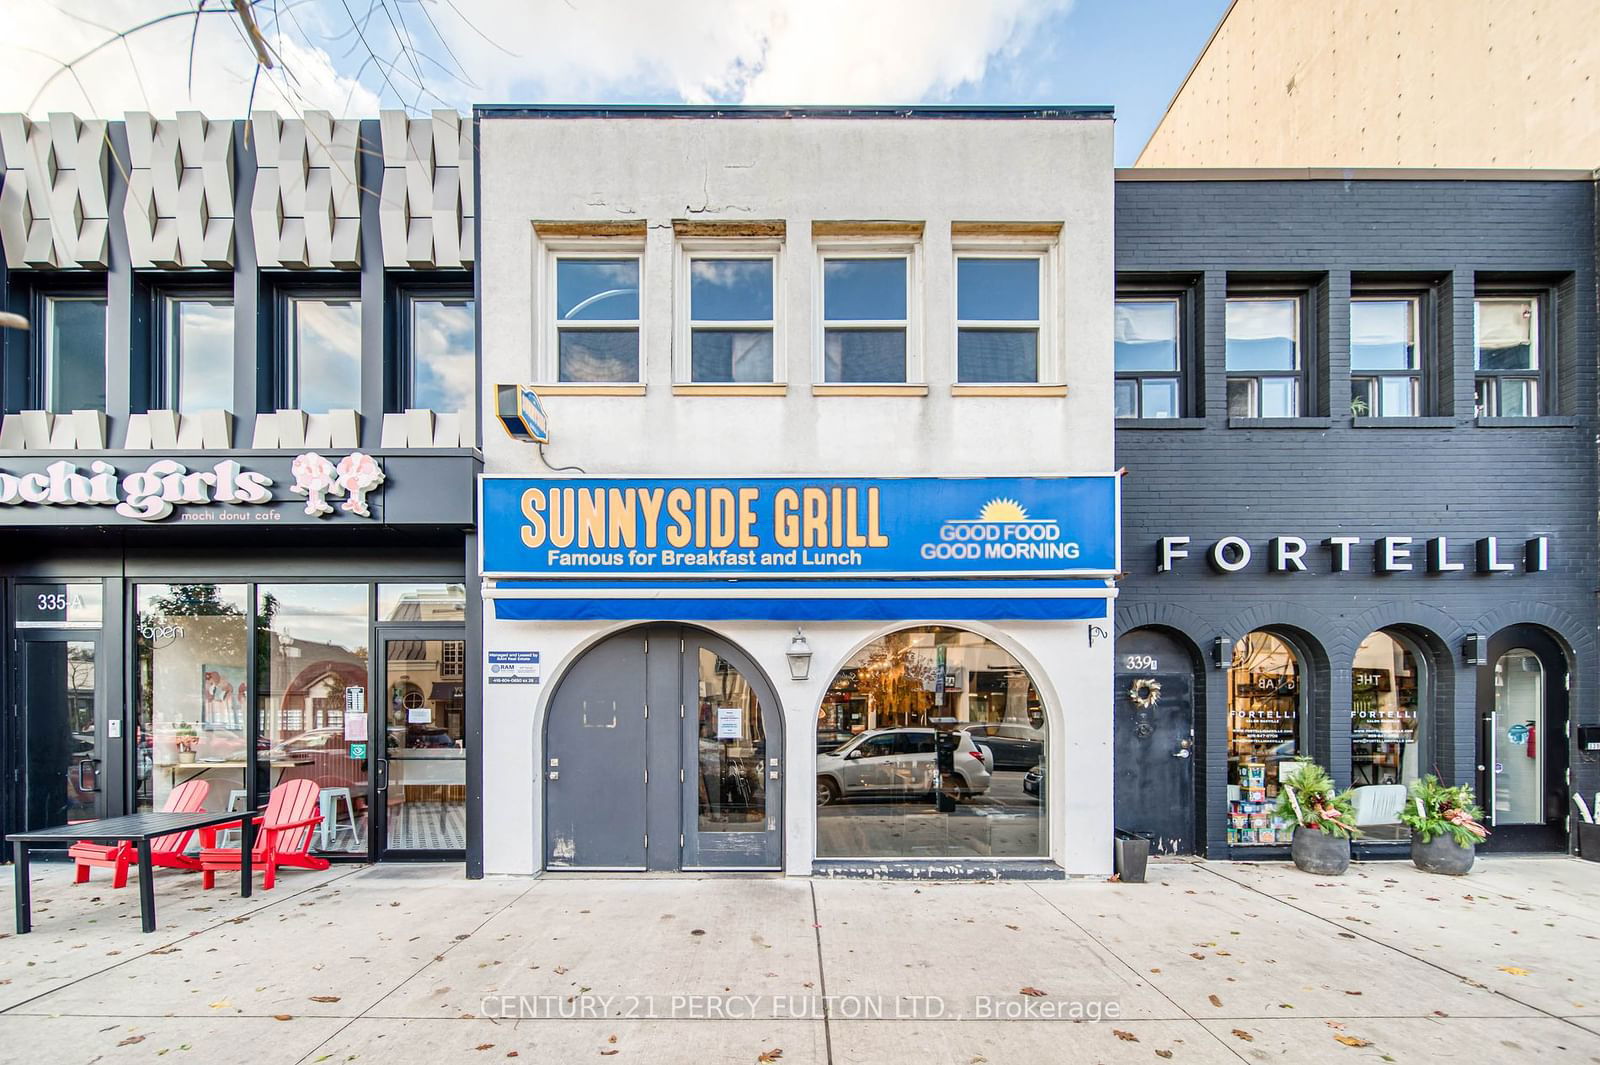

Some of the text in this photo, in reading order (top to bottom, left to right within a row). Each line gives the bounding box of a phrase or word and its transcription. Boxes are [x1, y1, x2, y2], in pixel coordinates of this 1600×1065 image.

[0, 459, 275, 521] ochigirls
[181, 509, 281, 520] mochi donut cafe
[520, 487, 890, 549] SUNNYSIDE GRILL
[940, 524, 1061, 541] GOOD FOOD
[547, 550, 862, 566] Famous for Breakfast and Lunch
[920, 542, 1080, 560] GOOD MORNING
[1161, 536, 1548, 572] FORTELLI
[142, 626, 184, 642] open
[1230, 710, 1296, 719] FORTELLI
[1350, 710, 1417, 719] FORTELLI
